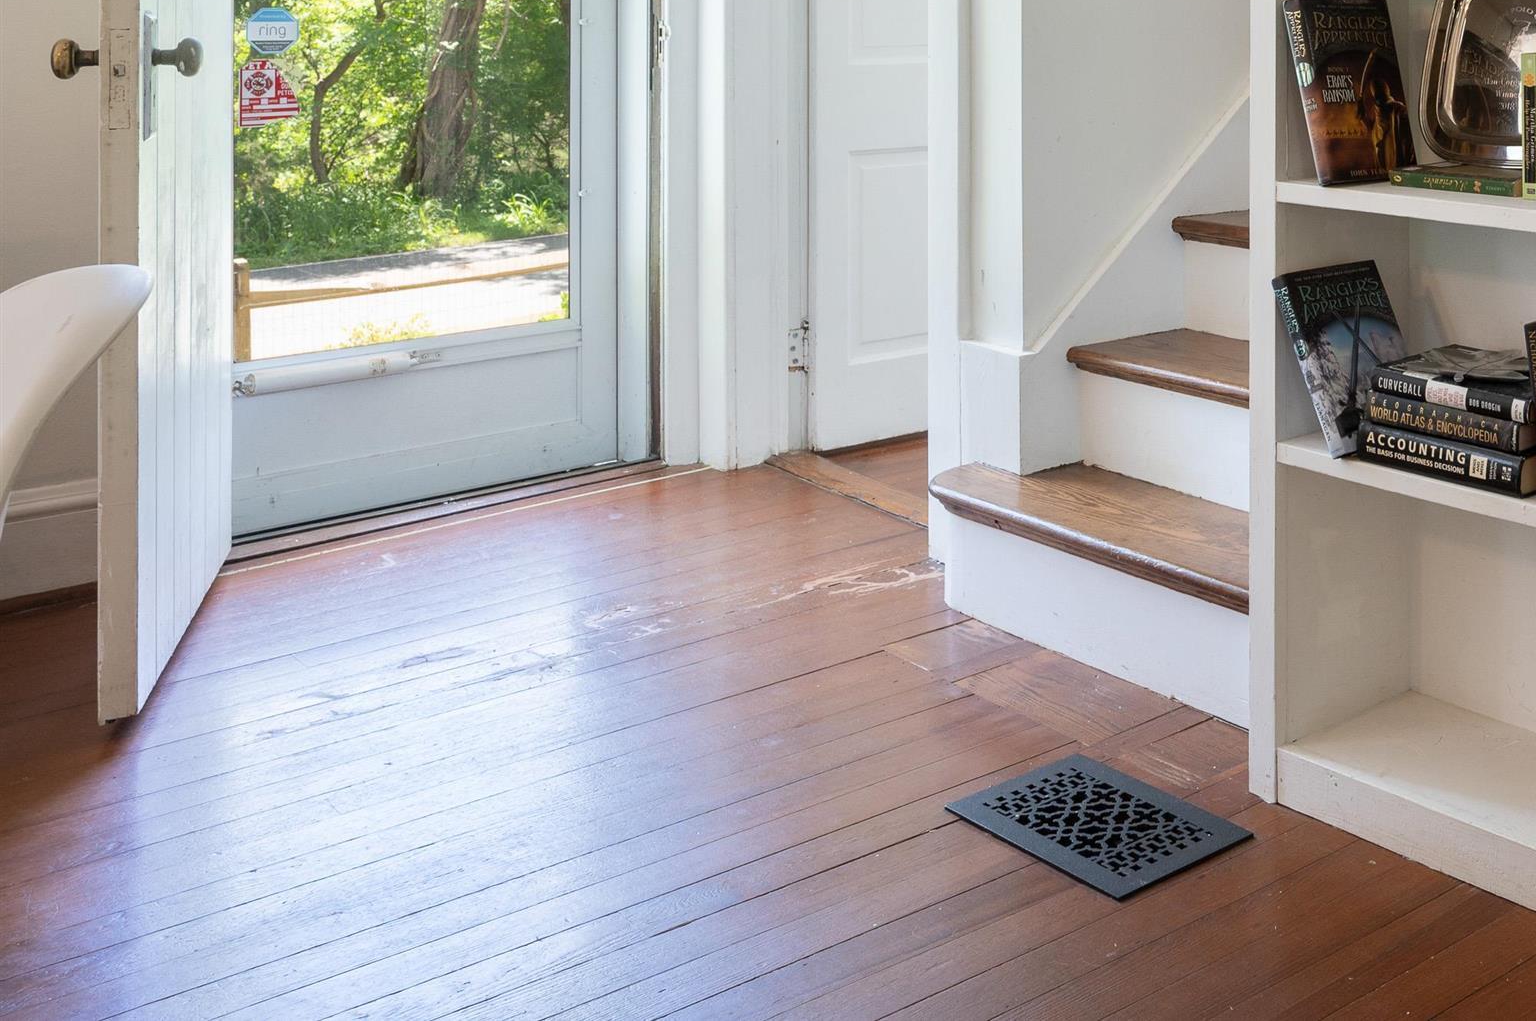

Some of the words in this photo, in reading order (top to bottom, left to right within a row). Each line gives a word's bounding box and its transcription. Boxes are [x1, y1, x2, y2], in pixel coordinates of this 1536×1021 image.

[258, 24, 286, 38] ring
[1322, 88, 1356, 104] RANSOM
[1299, 277, 1379, 301] RANGER'S
[1378, 376, 1422, 397] CURVEBALL
[1468, 398, 1480, 408] BOB
[1370, 405, 1399, 422] WORLD
[1400, 410, 1425, 428] ATLAS
[1427, 419, 1434, 430] &
[1436, 420, 1498, 445] ENCYCLOPEDIA
[1366, 431, 1466, 465] ACCOUNTING
[1366, 445, 1376, 455] THE
[1377, 447, 1393, 458] BASIS
[1394, 451, 1405, 461] FOR
[1407, 454, 1433, 468] BUSINESS
[1434, 460, 1465, 475] DECISIONS
